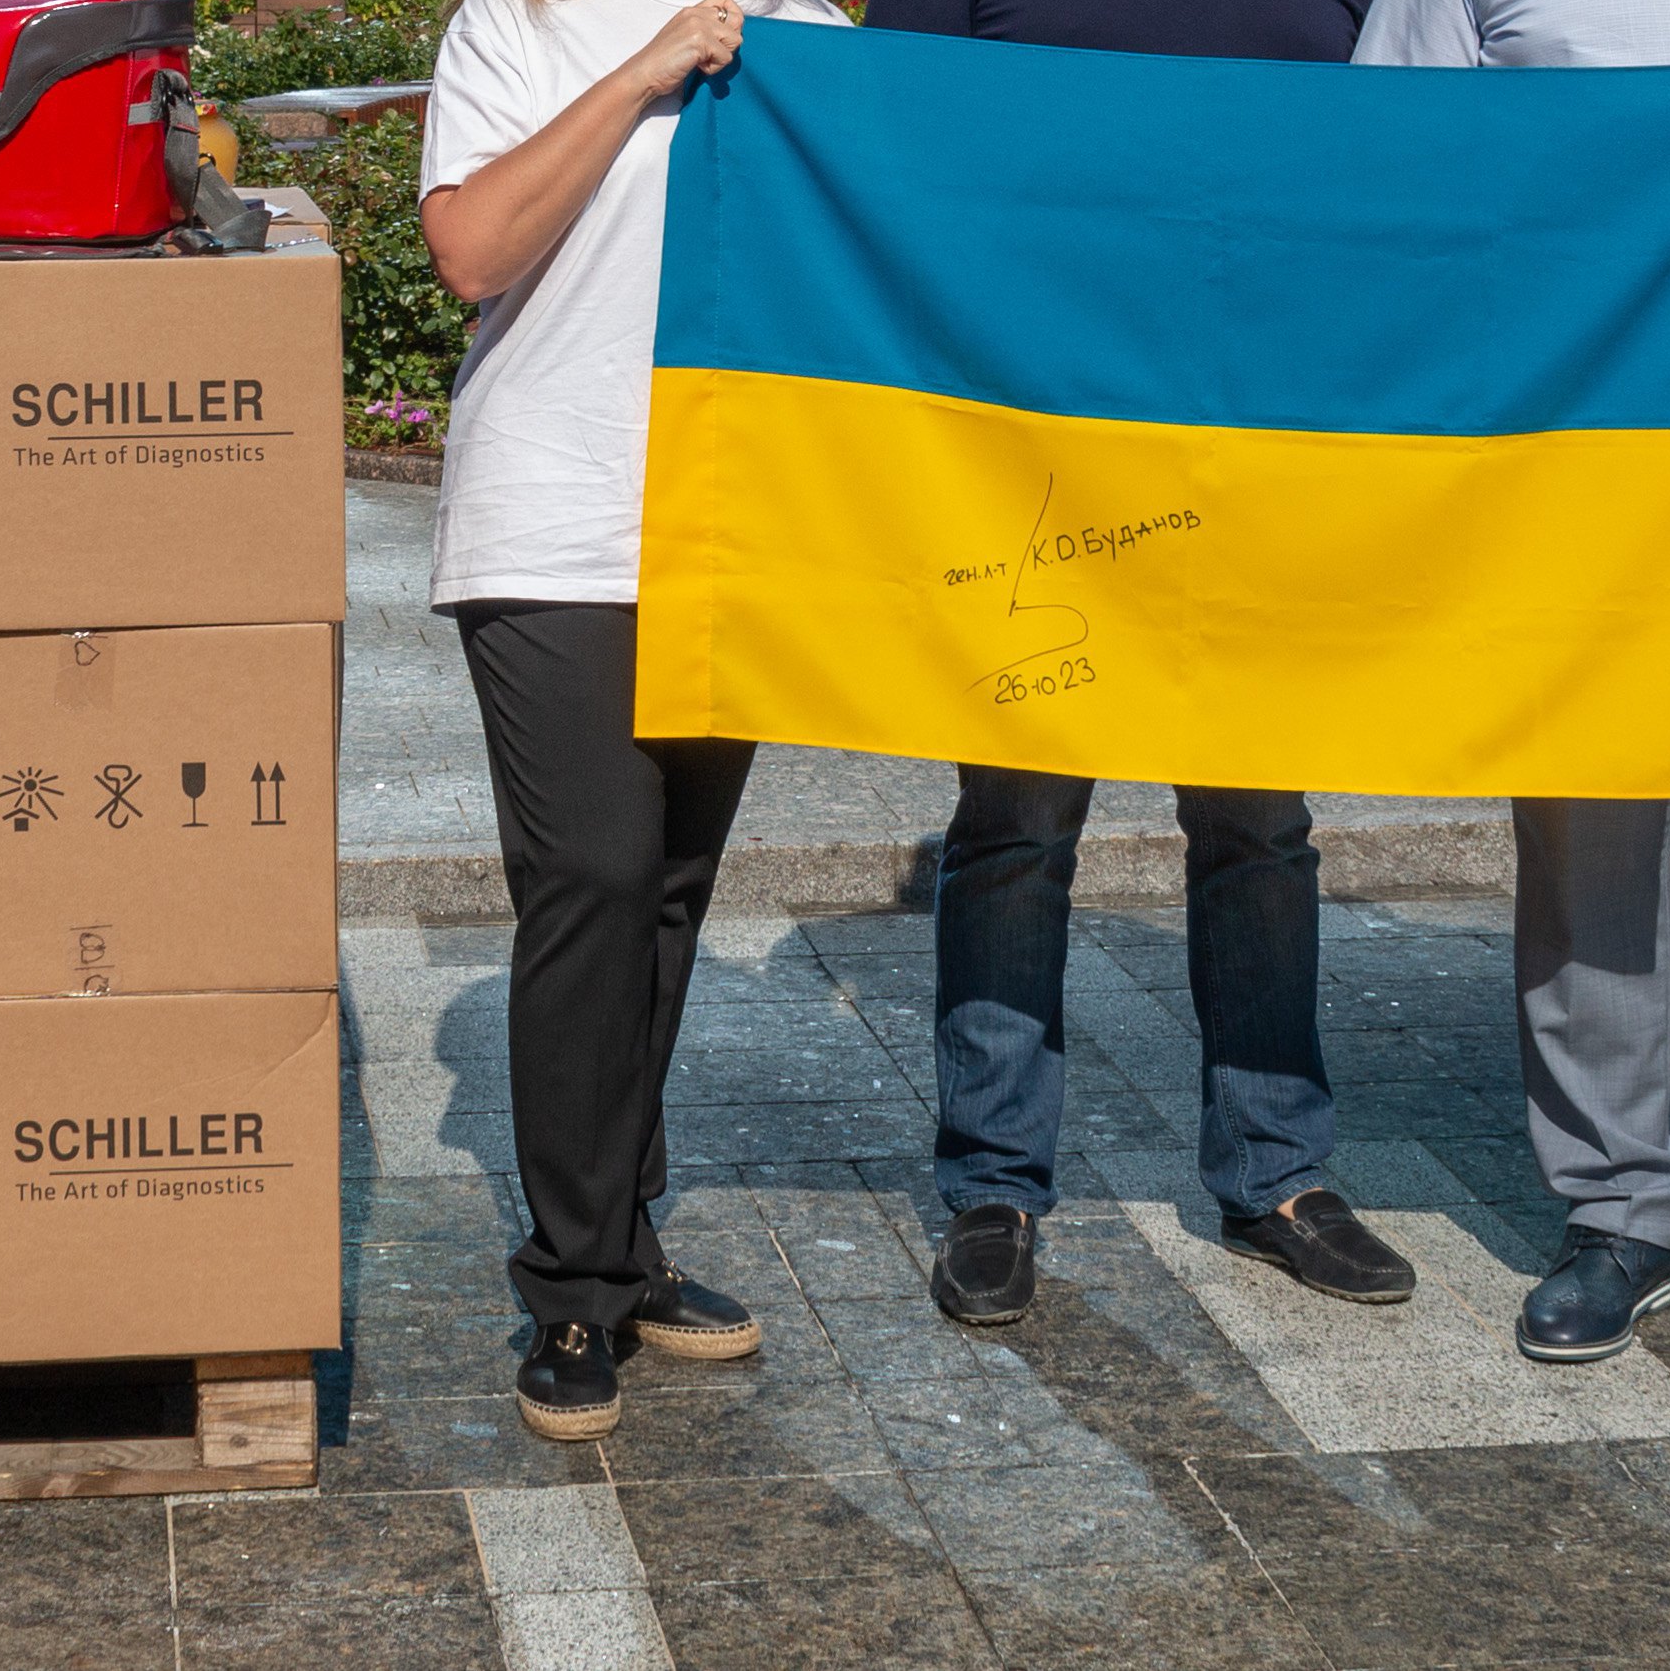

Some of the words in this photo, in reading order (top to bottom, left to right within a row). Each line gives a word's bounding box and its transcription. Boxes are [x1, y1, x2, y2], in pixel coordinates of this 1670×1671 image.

[12, 380, 263, 427] SCHILLER
[12, 447, 54, 467] The
[62, 447, 97, 466] Art
[105, 444, 128, 465] of
[136, 442, 265, 469] Diagnostics
[15, 1113, 262, 1163] SCHILLER
[15, 1182, 56, 1202] The
[63, 1181, 99, 1200] Art
[105, 1178, 129, 1199] of
[136, 1174, 265, 1201] Diagnostics
